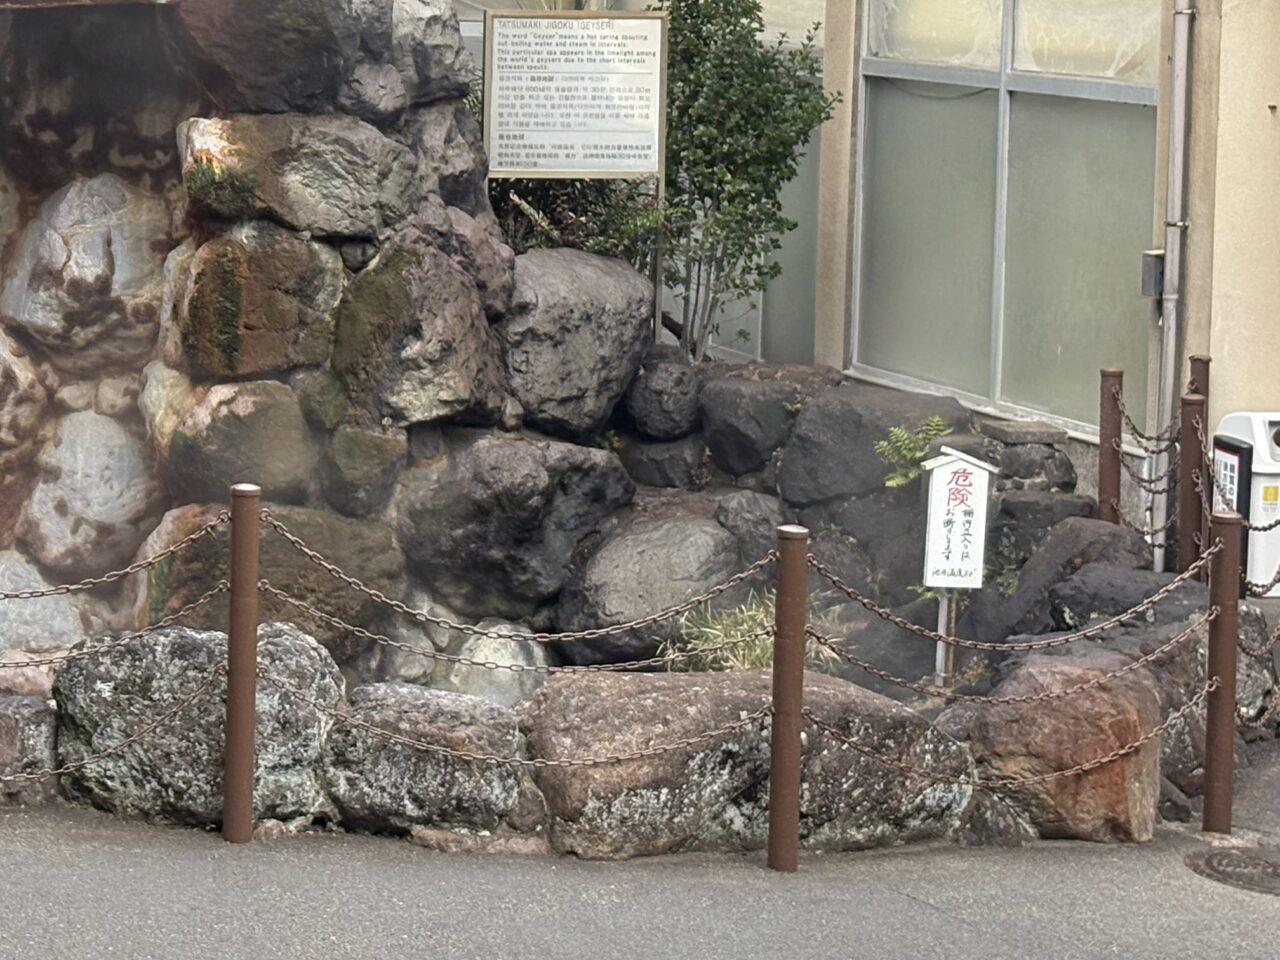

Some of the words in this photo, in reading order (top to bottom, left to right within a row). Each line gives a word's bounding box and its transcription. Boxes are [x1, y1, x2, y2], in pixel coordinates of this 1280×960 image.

[498, 21, 541, 29] TATSUMAKI
[545, 21, 573, 29] JIGOKU
[947, 467, 973, 508] 危険
